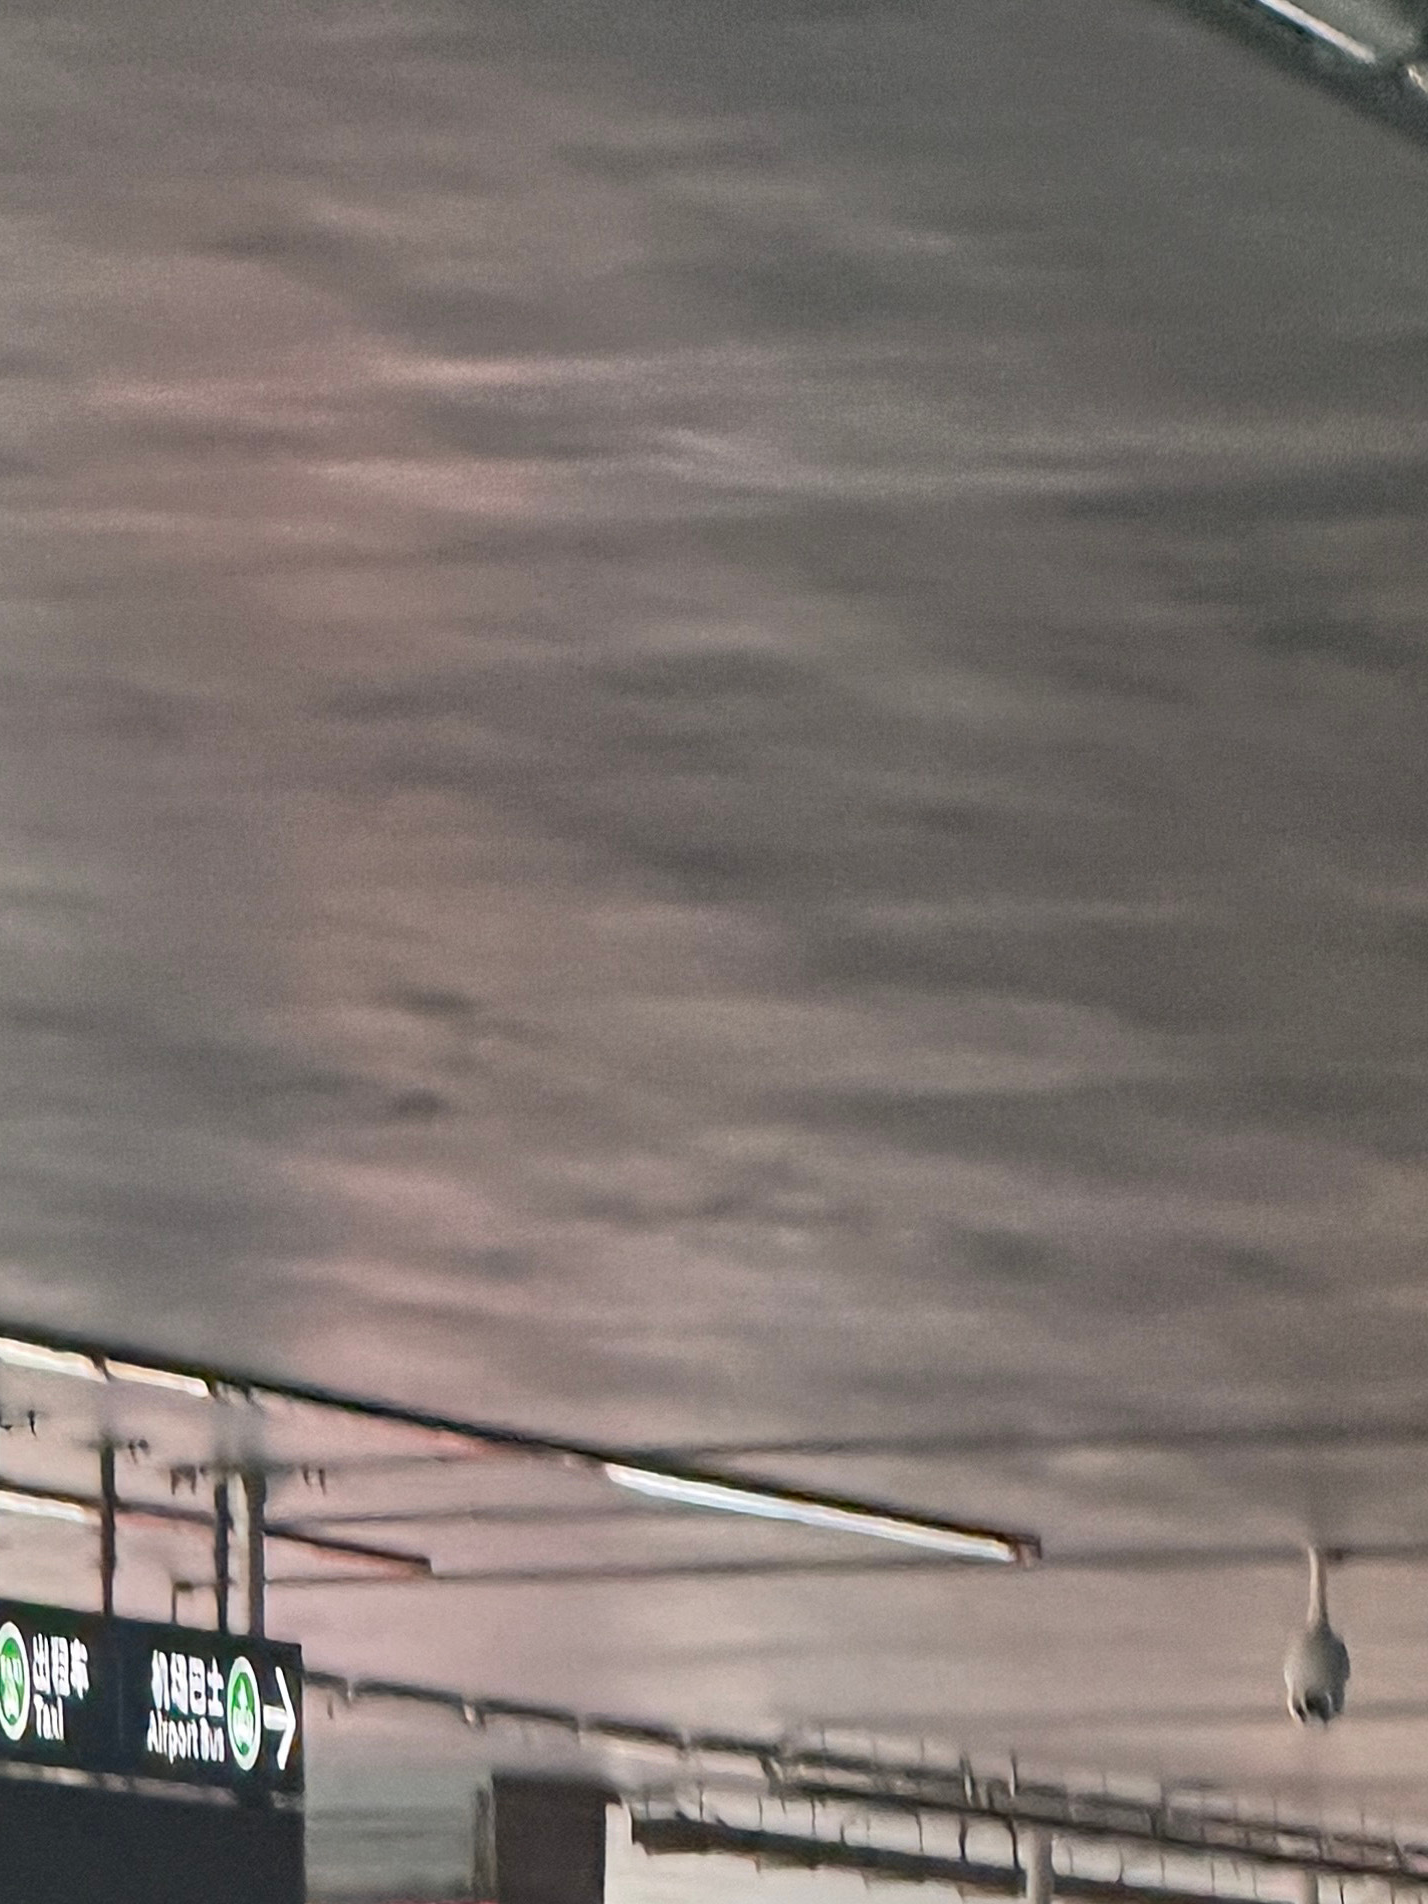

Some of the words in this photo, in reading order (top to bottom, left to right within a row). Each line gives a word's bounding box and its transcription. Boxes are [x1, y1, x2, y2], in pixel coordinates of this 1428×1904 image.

[33, 1633, 89, 1700] 出租车
[151, 1649, 224, 1717] 机场巴士
[33, 1693, 64, 1740] Taxi
[147, 1710, 199, 1764] Airport
[200, 1717, 224, 1762] Bus
